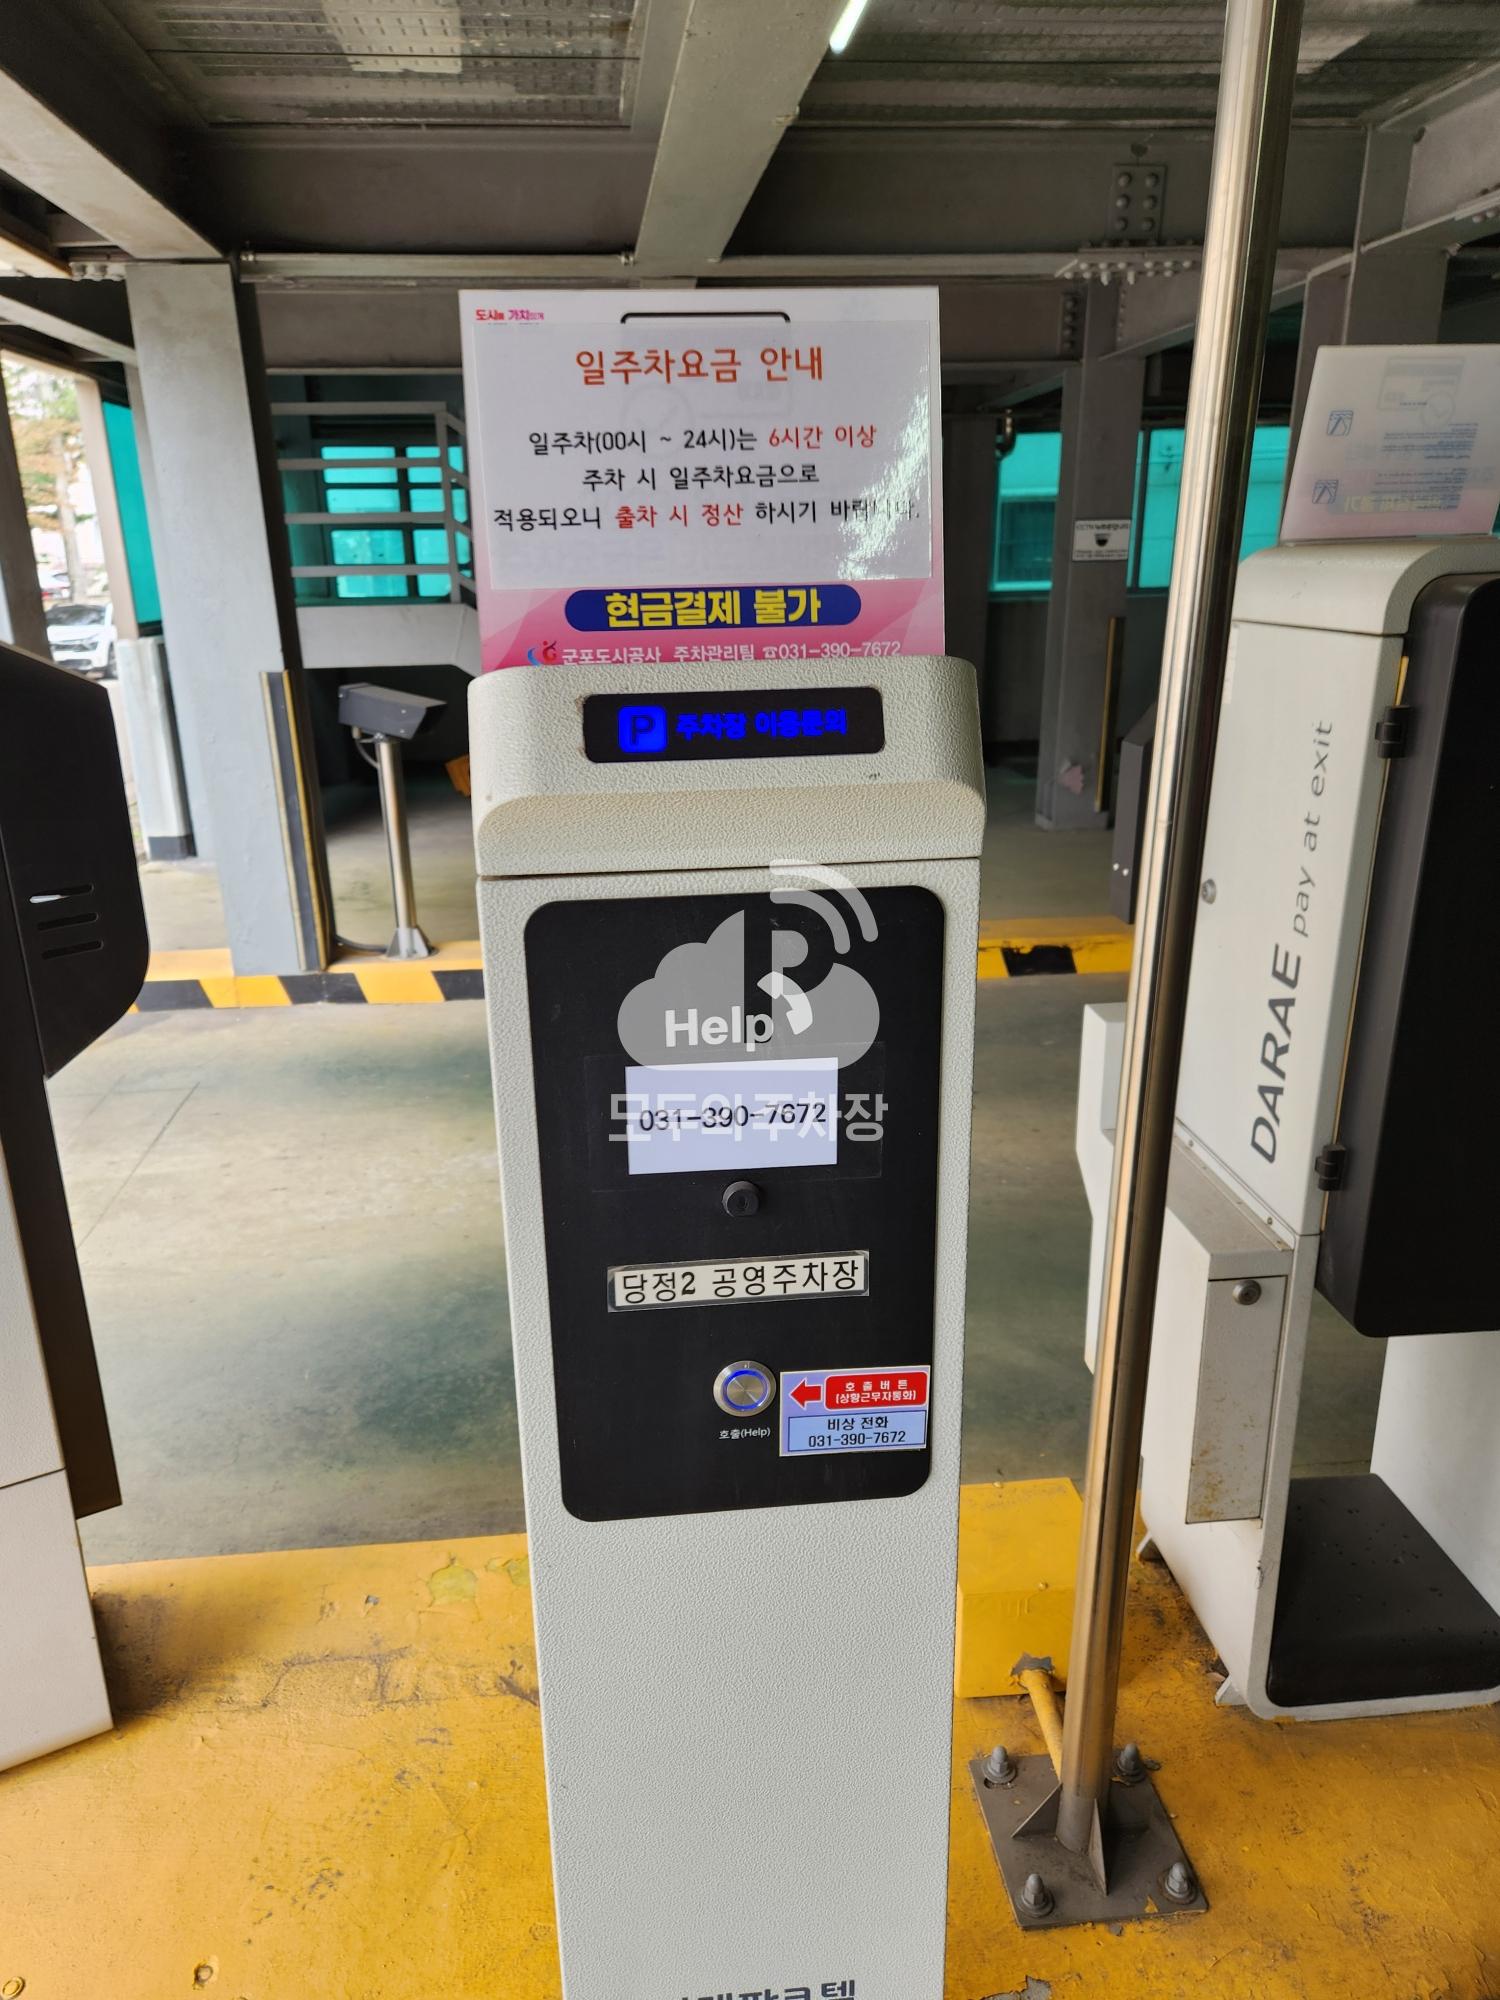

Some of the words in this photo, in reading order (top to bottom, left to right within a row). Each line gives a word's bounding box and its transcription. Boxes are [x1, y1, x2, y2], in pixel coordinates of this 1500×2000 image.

[575, 349, 741, 385] 일주차요금
[760, 346, 824, 381] 안내
[528, 431, 647, 456] 일주차(00시
[683, 426, 757, 451] 24시)는
[769, 426, 823, 449] 6시간
[835, 424, 877, 448] 이상
[582, 468, 625, 492] 주차
[637, 469, 657, 491] 시
[670, 464, 820, 491] 일주차요금으로
[493, 506, 601, 532] 적용되오니
[615, 505, 657, 528] 출차
[670, 505, 689, 527] 시
[701, 503, 743, 527] 정산
[755, 501, 817, 525] 하시기
[604, 591, 741, 628] 현금결제
[753, 588, 821, 625] 불가
[562, 647, 661, 665] 군포도시공사
[673, 644, 754, 663] 주차관리팀
[778, 641, 901, 660] 031-390-7672
[676, 712, 747, 741] 주차장
[755, 706, 848, 739] 이용문의
[1311, 719, 1333, 797] exit
[1304, 811, 1320, 851] at
[1293, 867, 1316, 938] pay
[665, 1005, 774, 1052] Help
[1250, 943, 1302, 1164] DARAE
[639, 1103, 827, 1131] 031-390-7672
[621, 1270, 697, 1304] 당정2
[712, 1258, 860, 1299] 공영주차장
[719, 1427, 771, 1440] 호출(Help)
[808, 1431, 906, 1448] 031-390-7672
[828, 1417, 856, 1431] 비상
[861, 1416, 889, 1430] 전화
